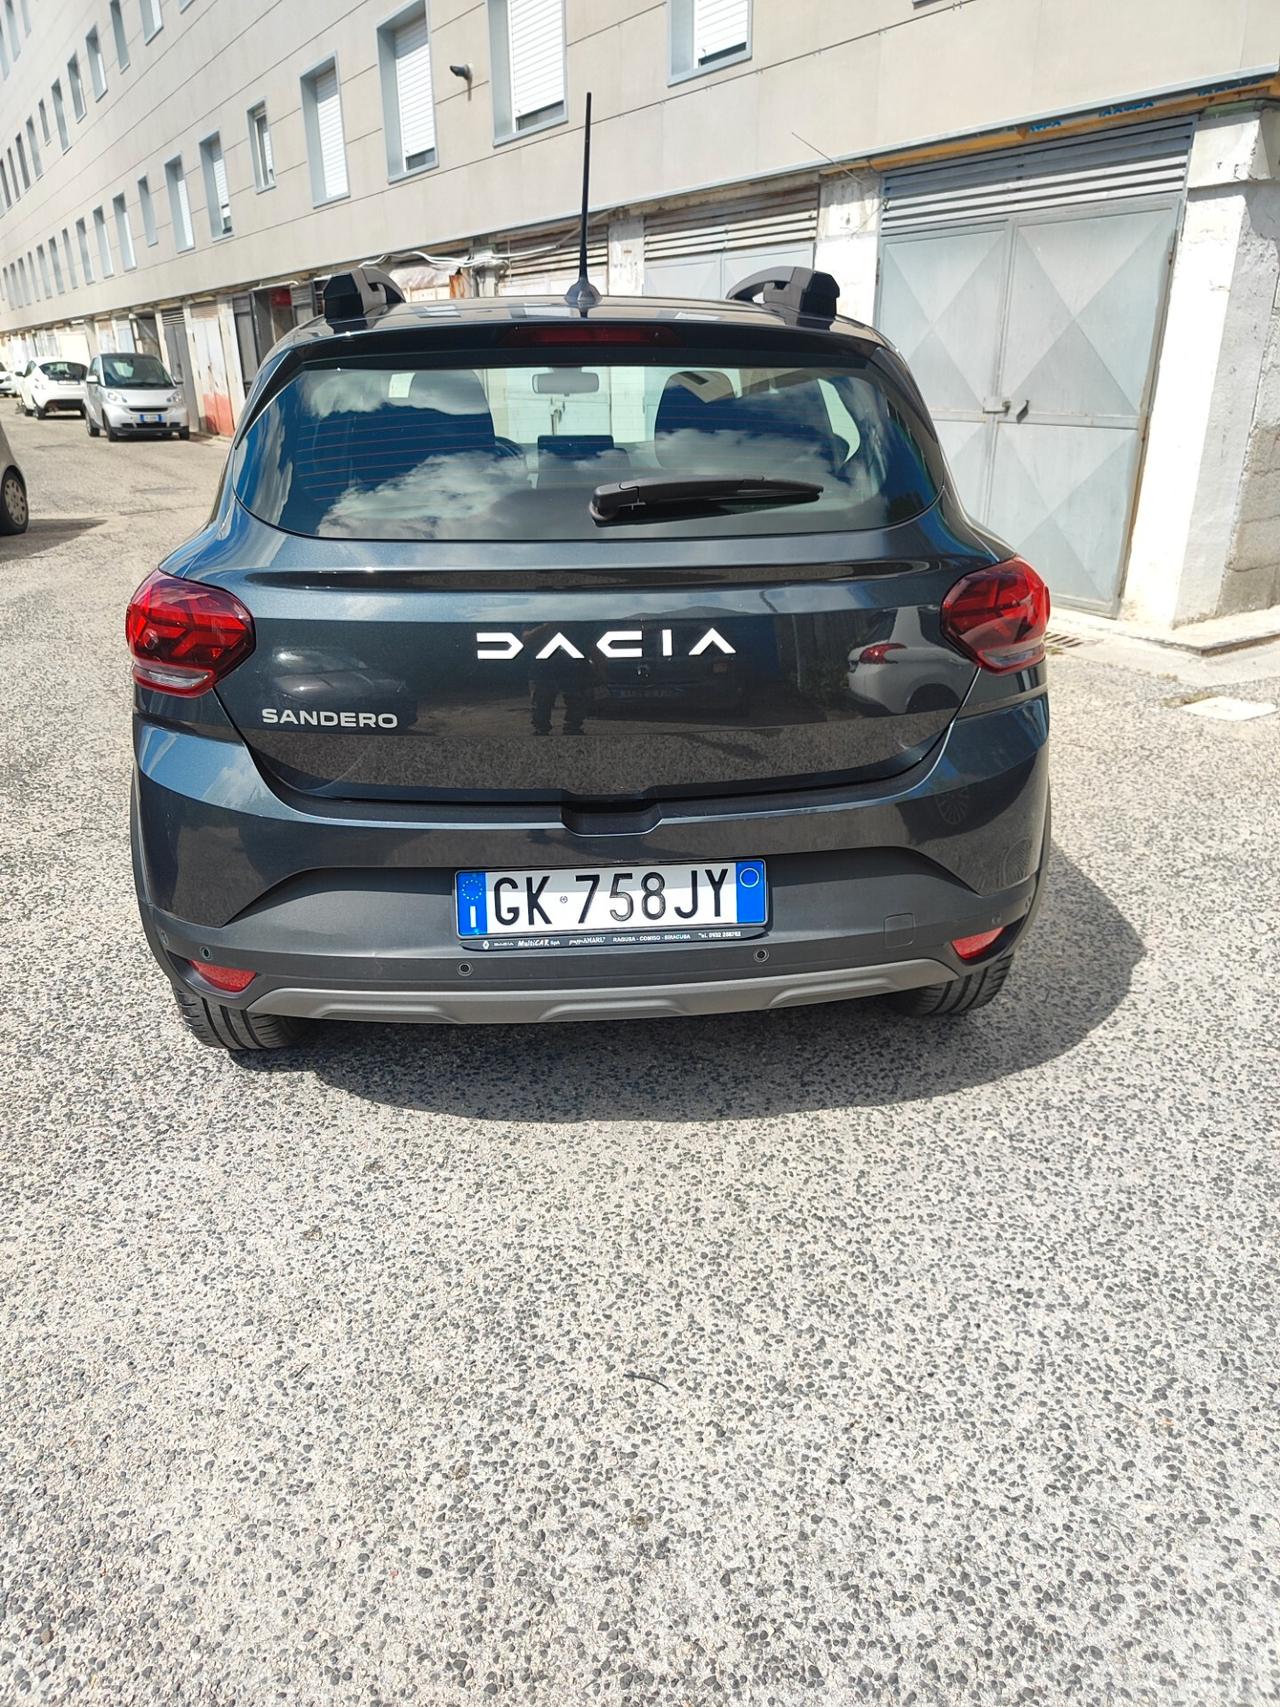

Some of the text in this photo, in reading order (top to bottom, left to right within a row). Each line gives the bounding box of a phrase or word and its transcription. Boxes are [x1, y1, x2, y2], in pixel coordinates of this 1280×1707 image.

[476, 628, 736, 660] DACIA
[262, 707, 399, 730] SANDERO
[493, 876, 553, 926] GK
